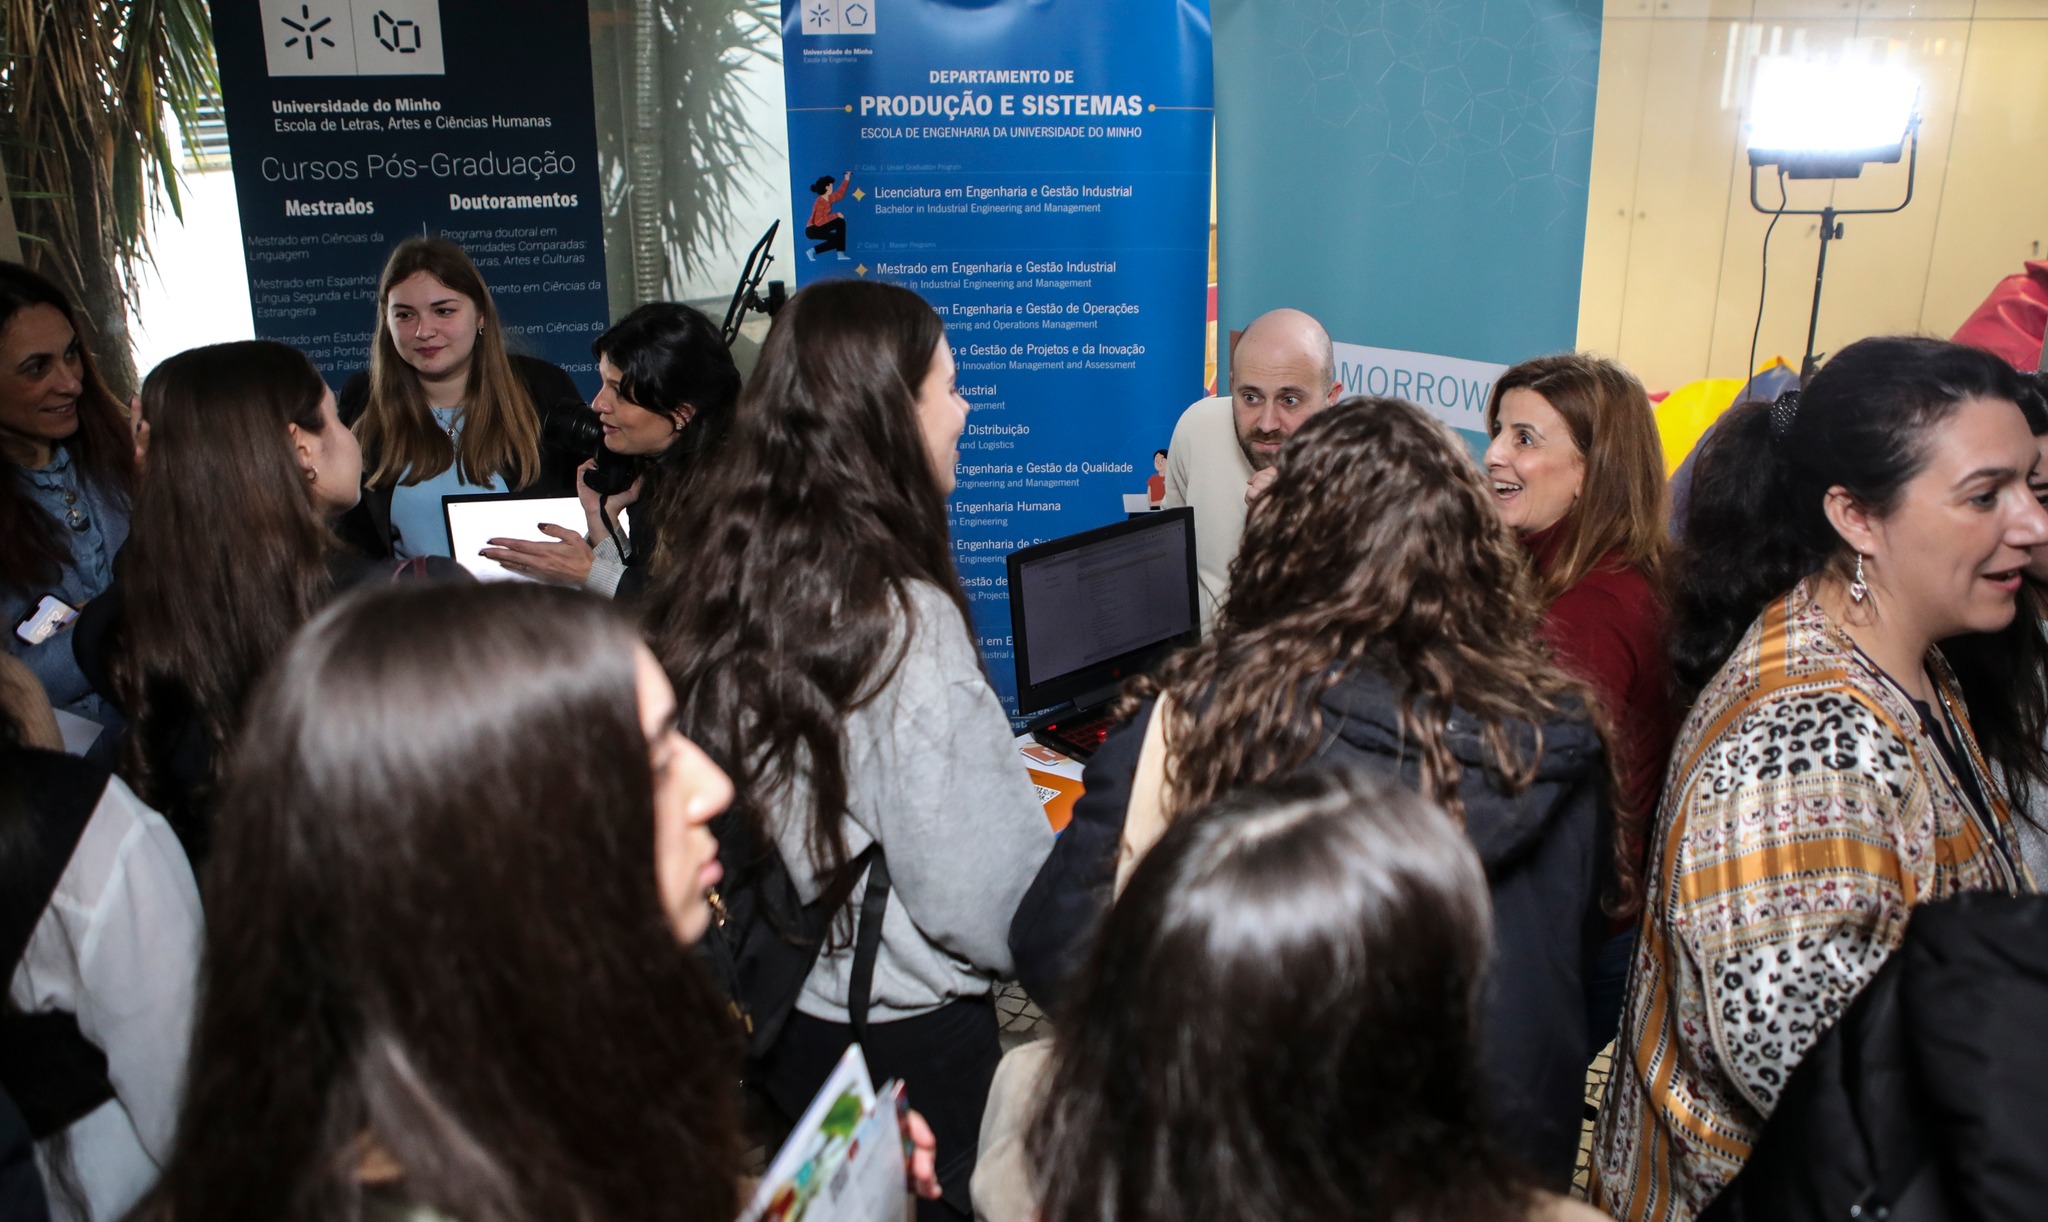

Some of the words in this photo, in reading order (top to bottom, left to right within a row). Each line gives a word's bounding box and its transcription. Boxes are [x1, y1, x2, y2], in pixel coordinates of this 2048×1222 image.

[853, 47, 874, 55] Minho
[929, 69, 1050, 84] DEPARTAMENTO
[1054, 70, 1074, 83] DE
[271, 99, 369, 114] Universidade
[372, 98, 391, 112] do
[395, 97, 441, 112] Minho
[860, 90, 993, 121] PRODUÇÃO
[1000, 95, 1015, 116] E
[1021, 95, 1143, 116] SISTEMAS
[274, 118, 317, 132] Escola
[320, 117, 337, 131] de
[340, 116, 384, 133] Letras,
[387, 115, 420, 130] Artes
[424, 119, 432, 129] e
[435, 114, 489, 130] Ciências
[491, 114, 552, 128] Humanas
[861, 127, 903, 139] ESCOLA
[905, 127, 920, 138] DE
[923, 127, 991, 138] ENGENHARIA
[993, 127, 1009, 138] DA
[1010, 126, 1086, 138] UNIVERSIDADE
[1088, 127, 1104, 138] DO
[1106, 127, 1142, 138] MINHO
[261, 156, 359, 182] Cursos
[367, 150, 576, 182] Pós-Graduação
[874, 185, 942, 199] Licenciatura
[945, 188, 963, 199] em
[965, 185, 1028, 200] Engenharia
[1030, 188, 1038, 197] e
[1041, 185, 1079, 197] Gestão
[1082, 184, 1133, 197] Industrial
[285, 197, 374, 217] Mestrados
[450, 192, 578, 211] Doutoramentos
[874, 203, 915, 214] Bachelor
[916, 203, 925, 214] in
[927, 203, 969, 213] Industrial
[970, 203, 1023, 215] Engineering
[1024, 203, 1041, 213] and
[1044, 203, 1101, 214] Management
[248, 232, 299, 247] Mestrado
[301, 234, 319, 244] em
[322, 231, 368, 244] Ciências
[370, 231, 385, 242] da
[440, 229, 492, 243] Programa
[494, 226, 538, 239] doutoral
[540, 227, 558, 237] em
[518, 238, 588, 252] Comparadas:
[249, 248, 310, 263] Linguagem
[503, 253, 531, 266] Artes
[533, 256, 541, 264] e
[542, 252, 586, 265] Culturas
[877, 262, 928, 275] Mestrado
[931, 265, 949, 274] em
[952, 262, 1013, 276] Engenharia
[1016, 265, 1023, 273] e
[1026, 261, 1064, 274] Gestão
[1066, 261, 1116, 274] Industrial
[253, 277, 304, 290] Mestrado
[306, 278, 324, 288] em
[523, 283, 541, 293] em
[542, 280, 586, 294] Ciências
[588, 279, 602, 291] da
[910, 280, 918, 289] in
[920, 279, 961, 289] Industrial
[963, 278, 1015, 291] Engineering
[1017, 278, 1033, 289] and
[1035, 278, 1092, 290] Management
[255, 291, 290, 306] Língua
[292, 289, 337, 304] Segunda
[340, 292, 349, 300] e
[257, 304, 317, 319] Estrangeira
[952, 303, 1013, 318] Engenharia
[1016, 306, 1023, 315] e
[1026, 303, 1064, 315] Gestão
[1066, 303, 1080, 314] de
[1083, 302, 1140, 317] Operações
[526, 324, 544, 335] em
[546, 320, 590, 334] Ciências
[591, 319, 605, 331] da
[975, 319, 991, 330] and
[993, 319, 1040, 331] Operations
[1042, 318, 1098, 331] Management
[312, 334, 331, 344] em
[960, 346, 967, 356] e
[970, 344, 1008, 356] Gestão
[1010, 343, 1024, 355] de
[1027, 343, 1069, 358] Projetos
[1072, 346, 1079, 355] e
[1081, 343, 1096, 355] da
[1098, 343, 1146, 357] Inovação
[962, 360, 1007, 371] Innovation
[1009, 360, 1065, 372] Management
[1066, 360, 1083, 370] and
[1085, 359, 1136, 370] Assessment
[1333, 361, 1490, 413] MORROW
[968, 424, 1030, 436] Distribuição
[959, 441, 976, 450] and
[978, 440, 1015, 451] Logistics
[955, 463, 1014, 476] Engenharia
[1016, 466, 1024, 474] e
[1026, 462, 1064, 474] Gestão
[1065, 462, 1079, 473] da
[1081, 462, 1133, 475] Qualidade
[956, 478, 1006, 490] Engineering
[1007, 478, 1023, 488] and
[1025, 478, 1080, 490] Management
[956, 501, 1014, 515] Engenharia
[1017, 501, 1061, 512] Humana
[959, 517, 1009, 528] Engineering
[957, 539, 1014, 552] Engenharia
[1016, 539, 1031, 550] de
[958, 576, 993, 588] Gestão
[995, 575, 1008, 587] de
[978, 590, 1010, 601] Projects
[986, 638, 1003, 647] em
